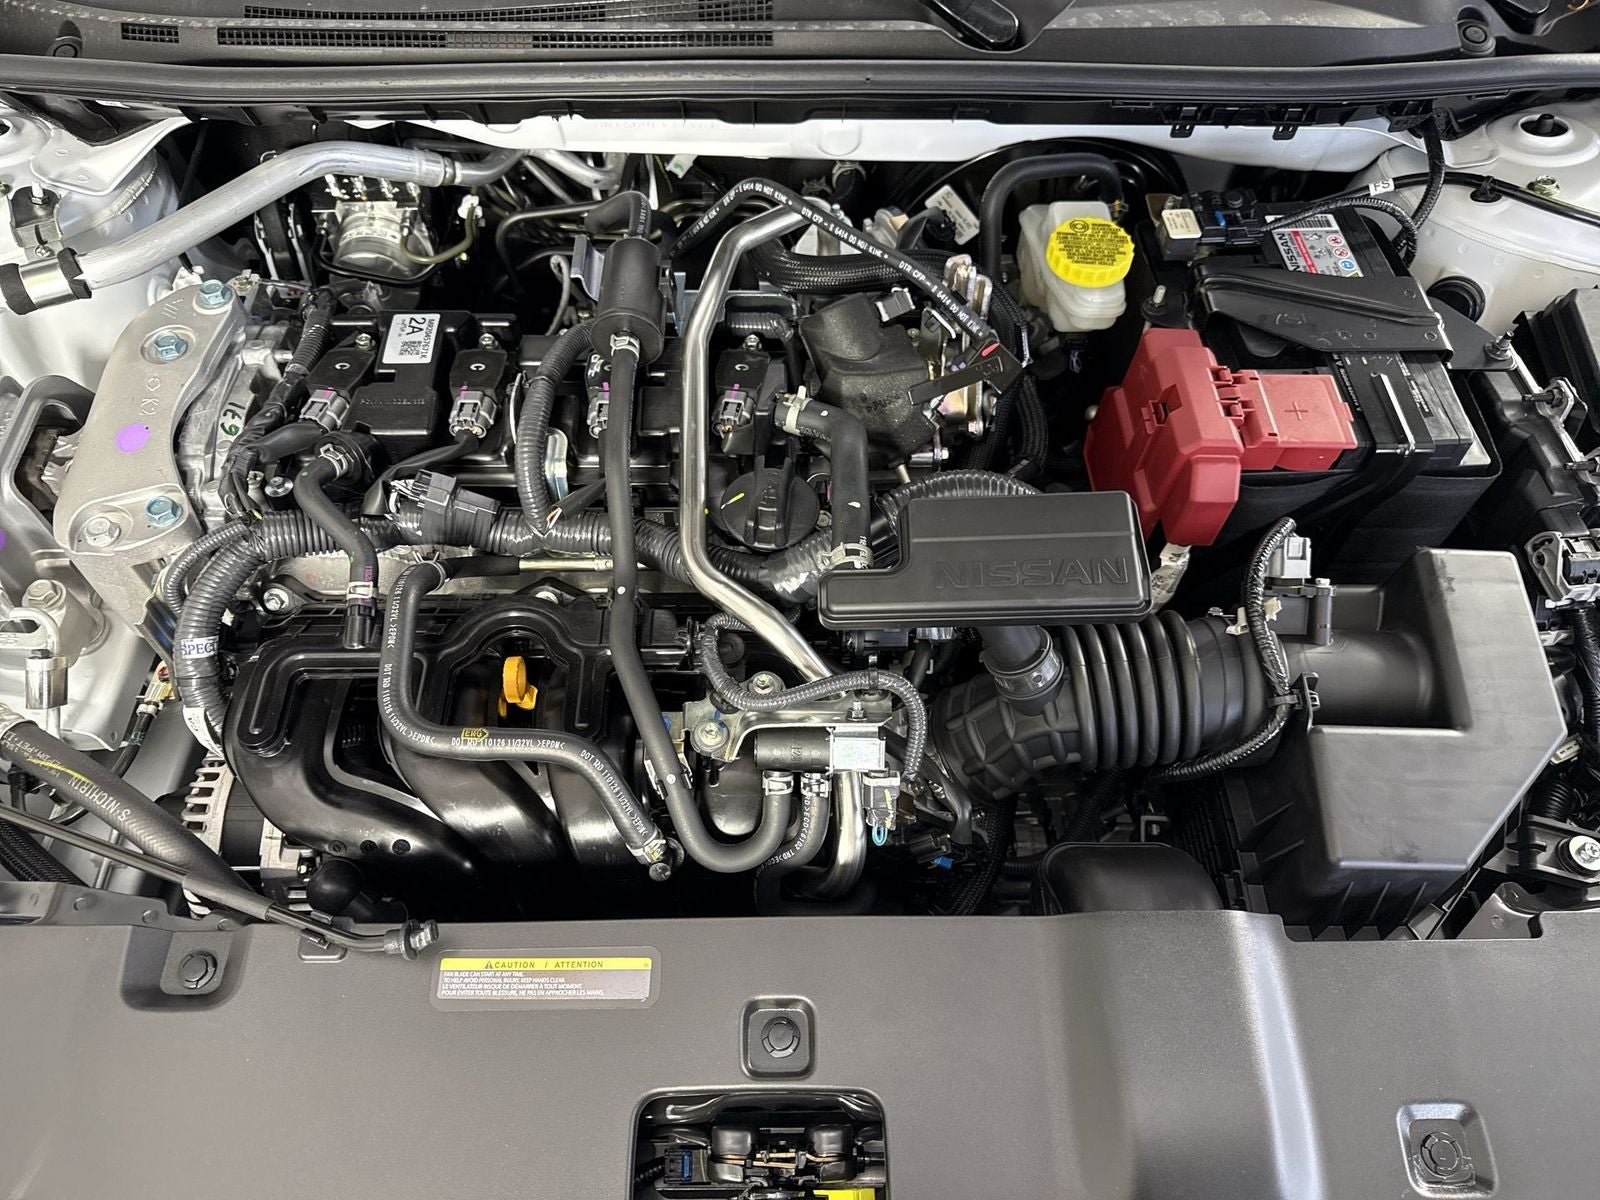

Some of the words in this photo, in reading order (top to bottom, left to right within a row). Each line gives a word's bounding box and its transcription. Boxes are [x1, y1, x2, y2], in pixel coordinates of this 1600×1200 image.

[406, 317, 426, 335] 2A
[950, 303, 958, 313] DO
[957, 311, 969, 322] NOT
[966, 320, 980, 333] KINK
[936, 556, 1130, 589] NISSAN
[580, 749, 594, 762] DOT
